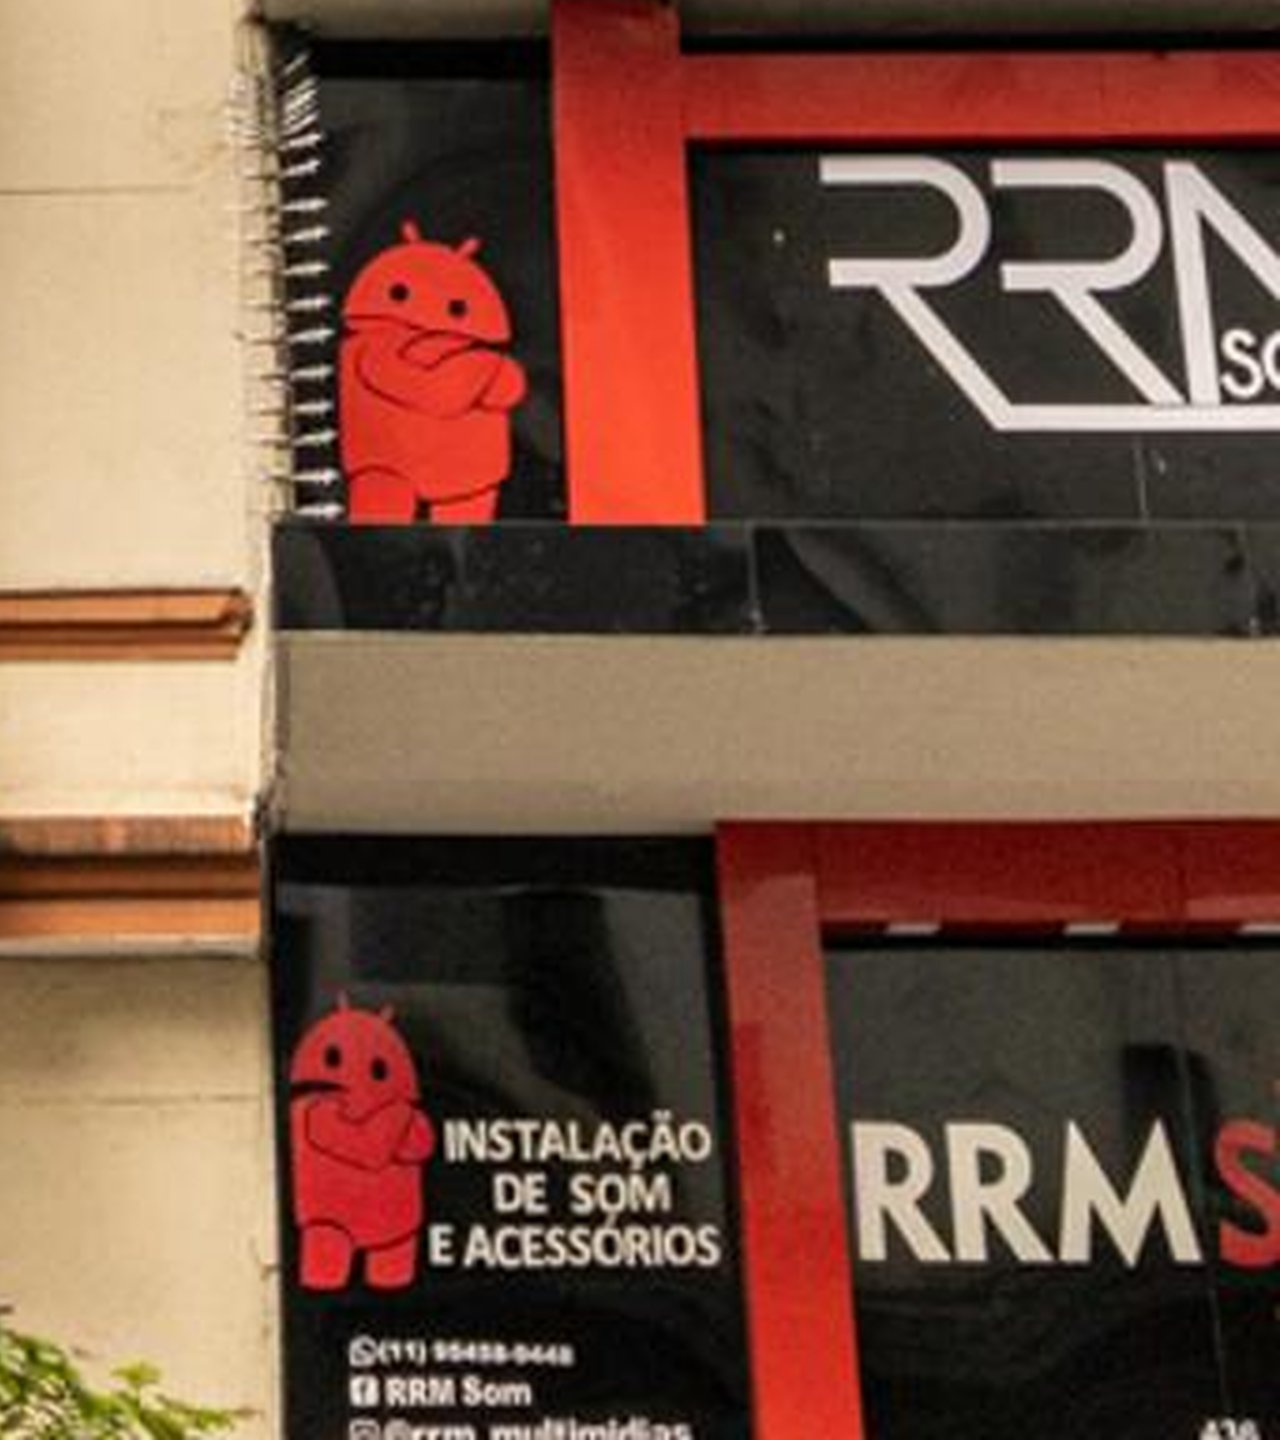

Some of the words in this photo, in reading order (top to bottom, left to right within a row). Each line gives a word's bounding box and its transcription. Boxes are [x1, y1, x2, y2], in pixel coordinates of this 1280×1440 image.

[443, 1110, 712, 1170] INSTALAÇÃO
[494, 1173, 548, 1214] DE
[570, 1173, 671, 1215] SOM
[429, 1225, 454, 1265] E
[463, 1212, 721, 1268] ACESSÓRIOS
[385, 1376, 456, 1407] RRM
[461, 1375, 533, 1407] Som
